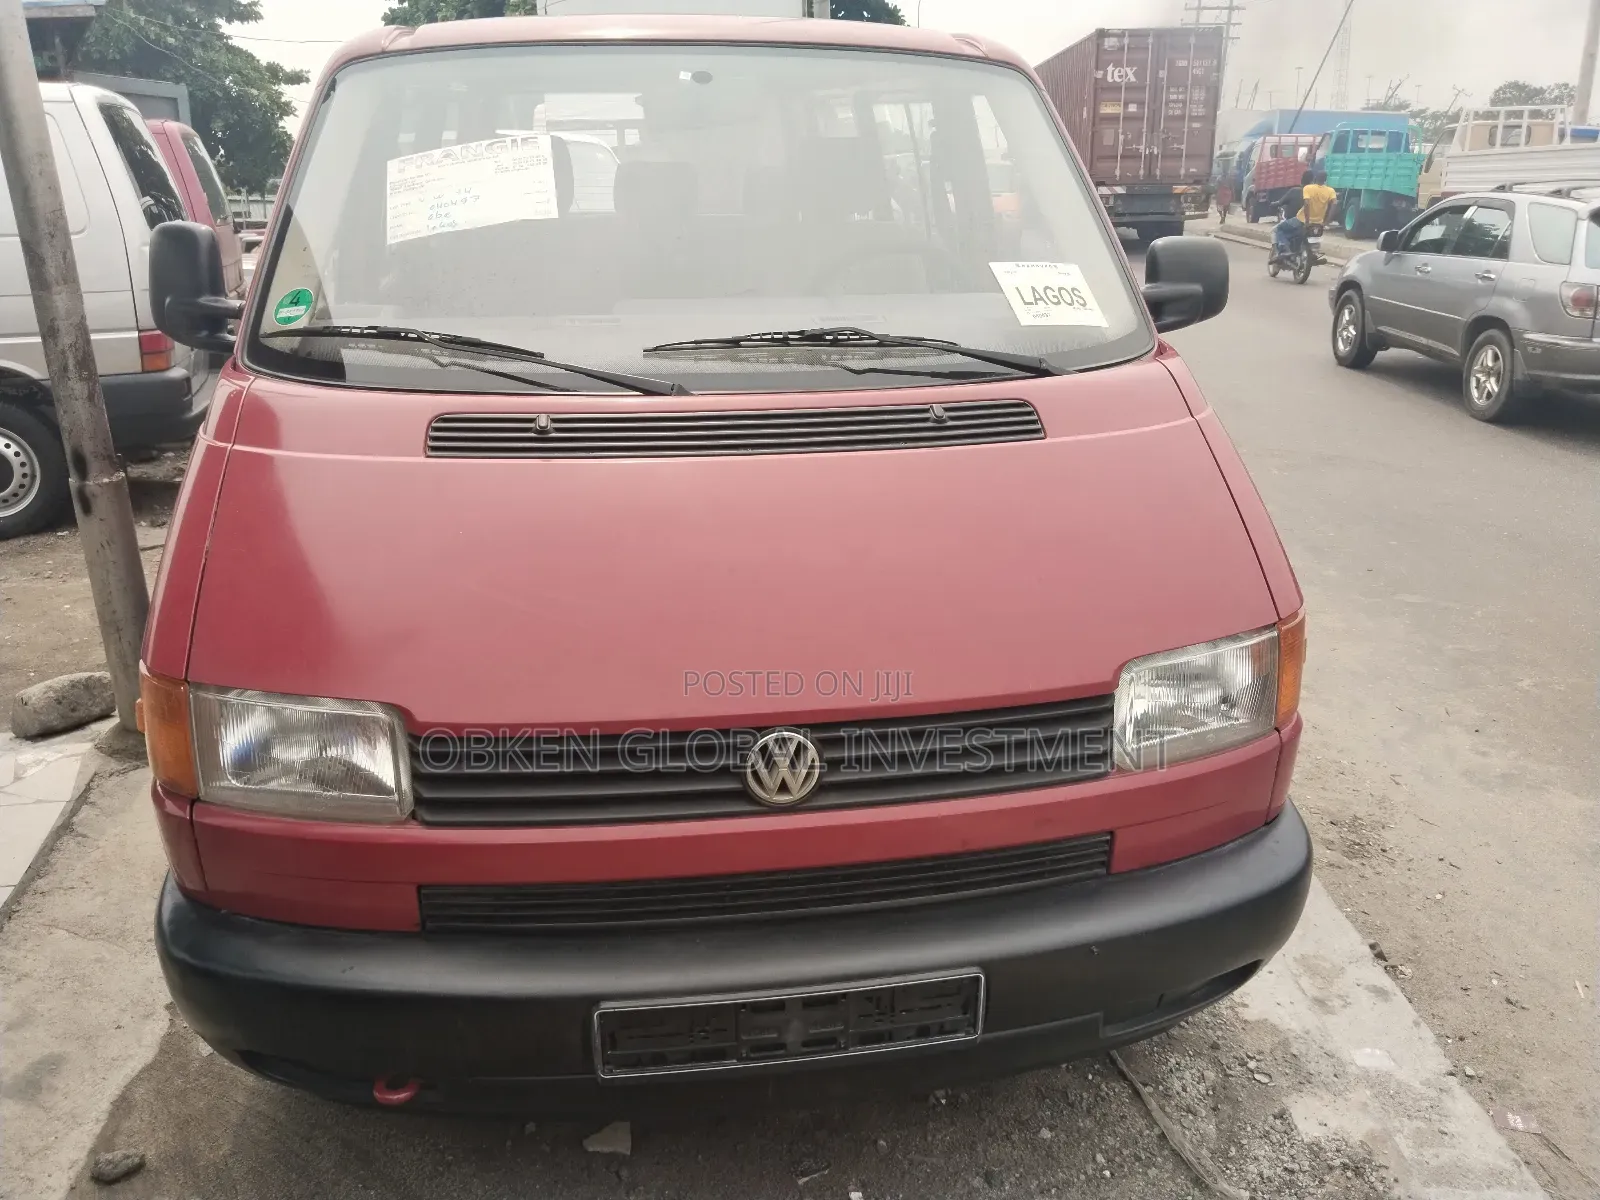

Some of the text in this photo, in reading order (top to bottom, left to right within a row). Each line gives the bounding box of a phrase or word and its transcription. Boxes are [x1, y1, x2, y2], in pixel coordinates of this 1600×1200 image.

[1106, 62, 1138, 83] tex
[397, 136, 540, 174] FRANGIE
[289, 290, 301, 306] 4
[1015, 285, 1088, 307] LAGOS
